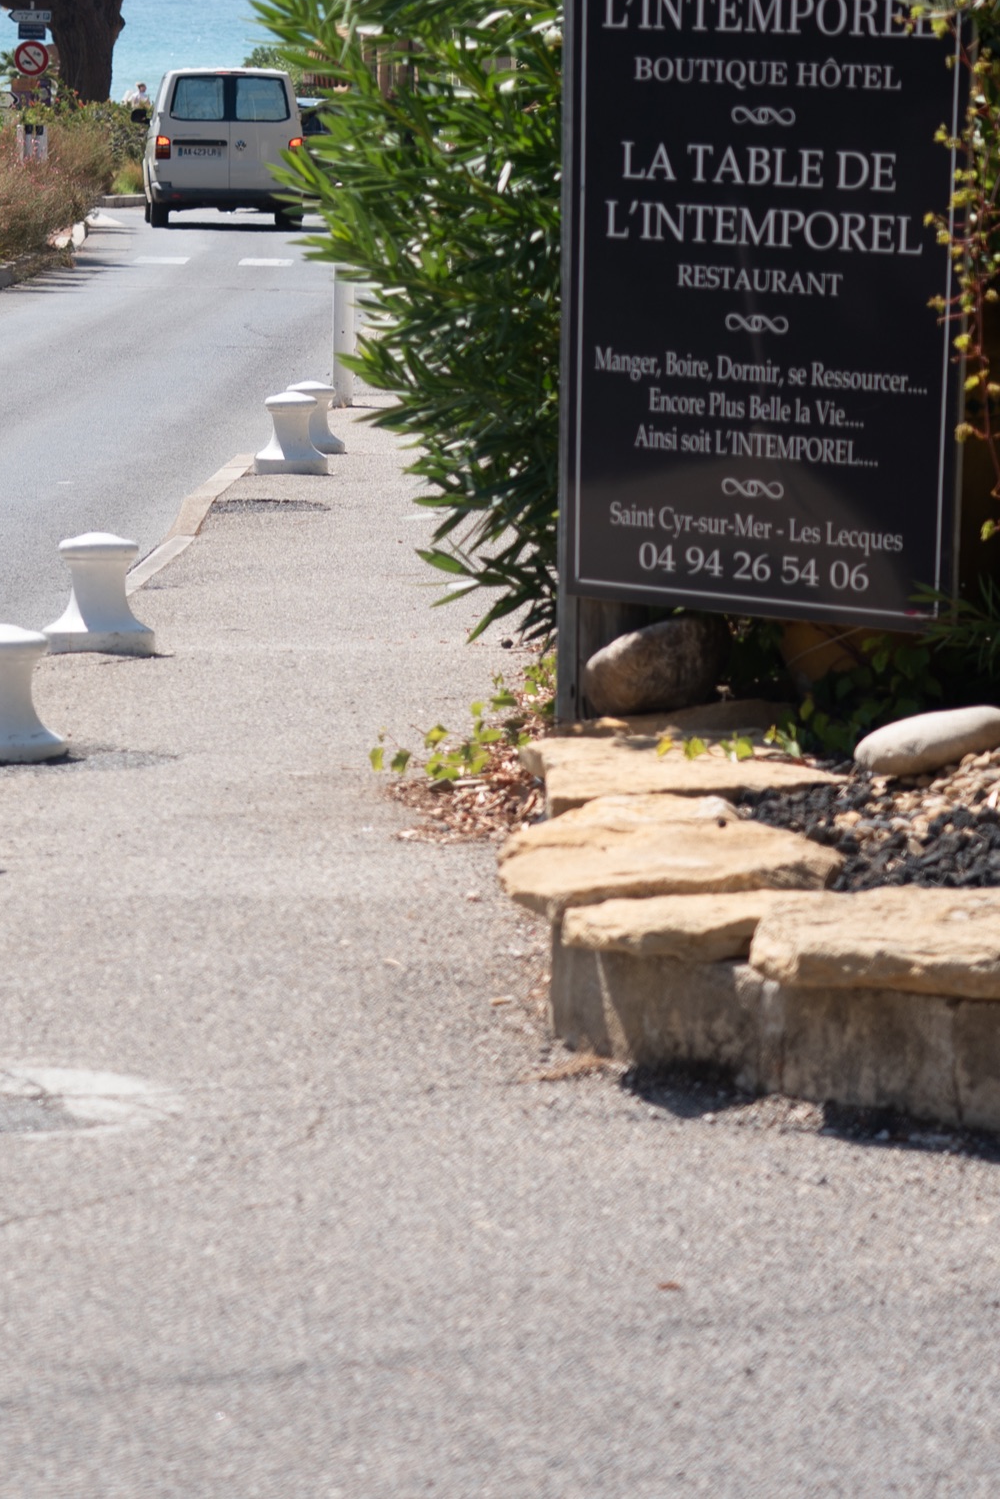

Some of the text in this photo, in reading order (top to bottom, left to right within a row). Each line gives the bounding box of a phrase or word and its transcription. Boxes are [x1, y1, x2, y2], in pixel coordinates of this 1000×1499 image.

[634, 57, 902, 90] BOUTIQUE HÔTEL
[621, 141, 897, 191] LA TABLE DE
[605, 200, 923, 255] L'INTEMPOREL
[677, 264, 843, 296] RESTAURANT
[595, 346, 661, 382] Manger,
[665, 351, 713, 382] Boire,
[717, 355, 784, 387] Dormir,
[788, 367, 806, 385] se
[649, 387, 705, 415] Encore
[708, 392, 745, 419] Plus
[749, 395, 791, 422] Belle
[795, 398, 813, 423] la
[634, 424, 678, 451] Ainsi
[680, 428, 711, 454] soit
[609, 502, 654, 528] Saint
[658, 506, 772, 539] Cyr-sur-Mer
[789, 518, 821, 544] Les
[825, 521, 904, 556] Lecques
[638, 541, 869, 592] 04 94 26 54 06
